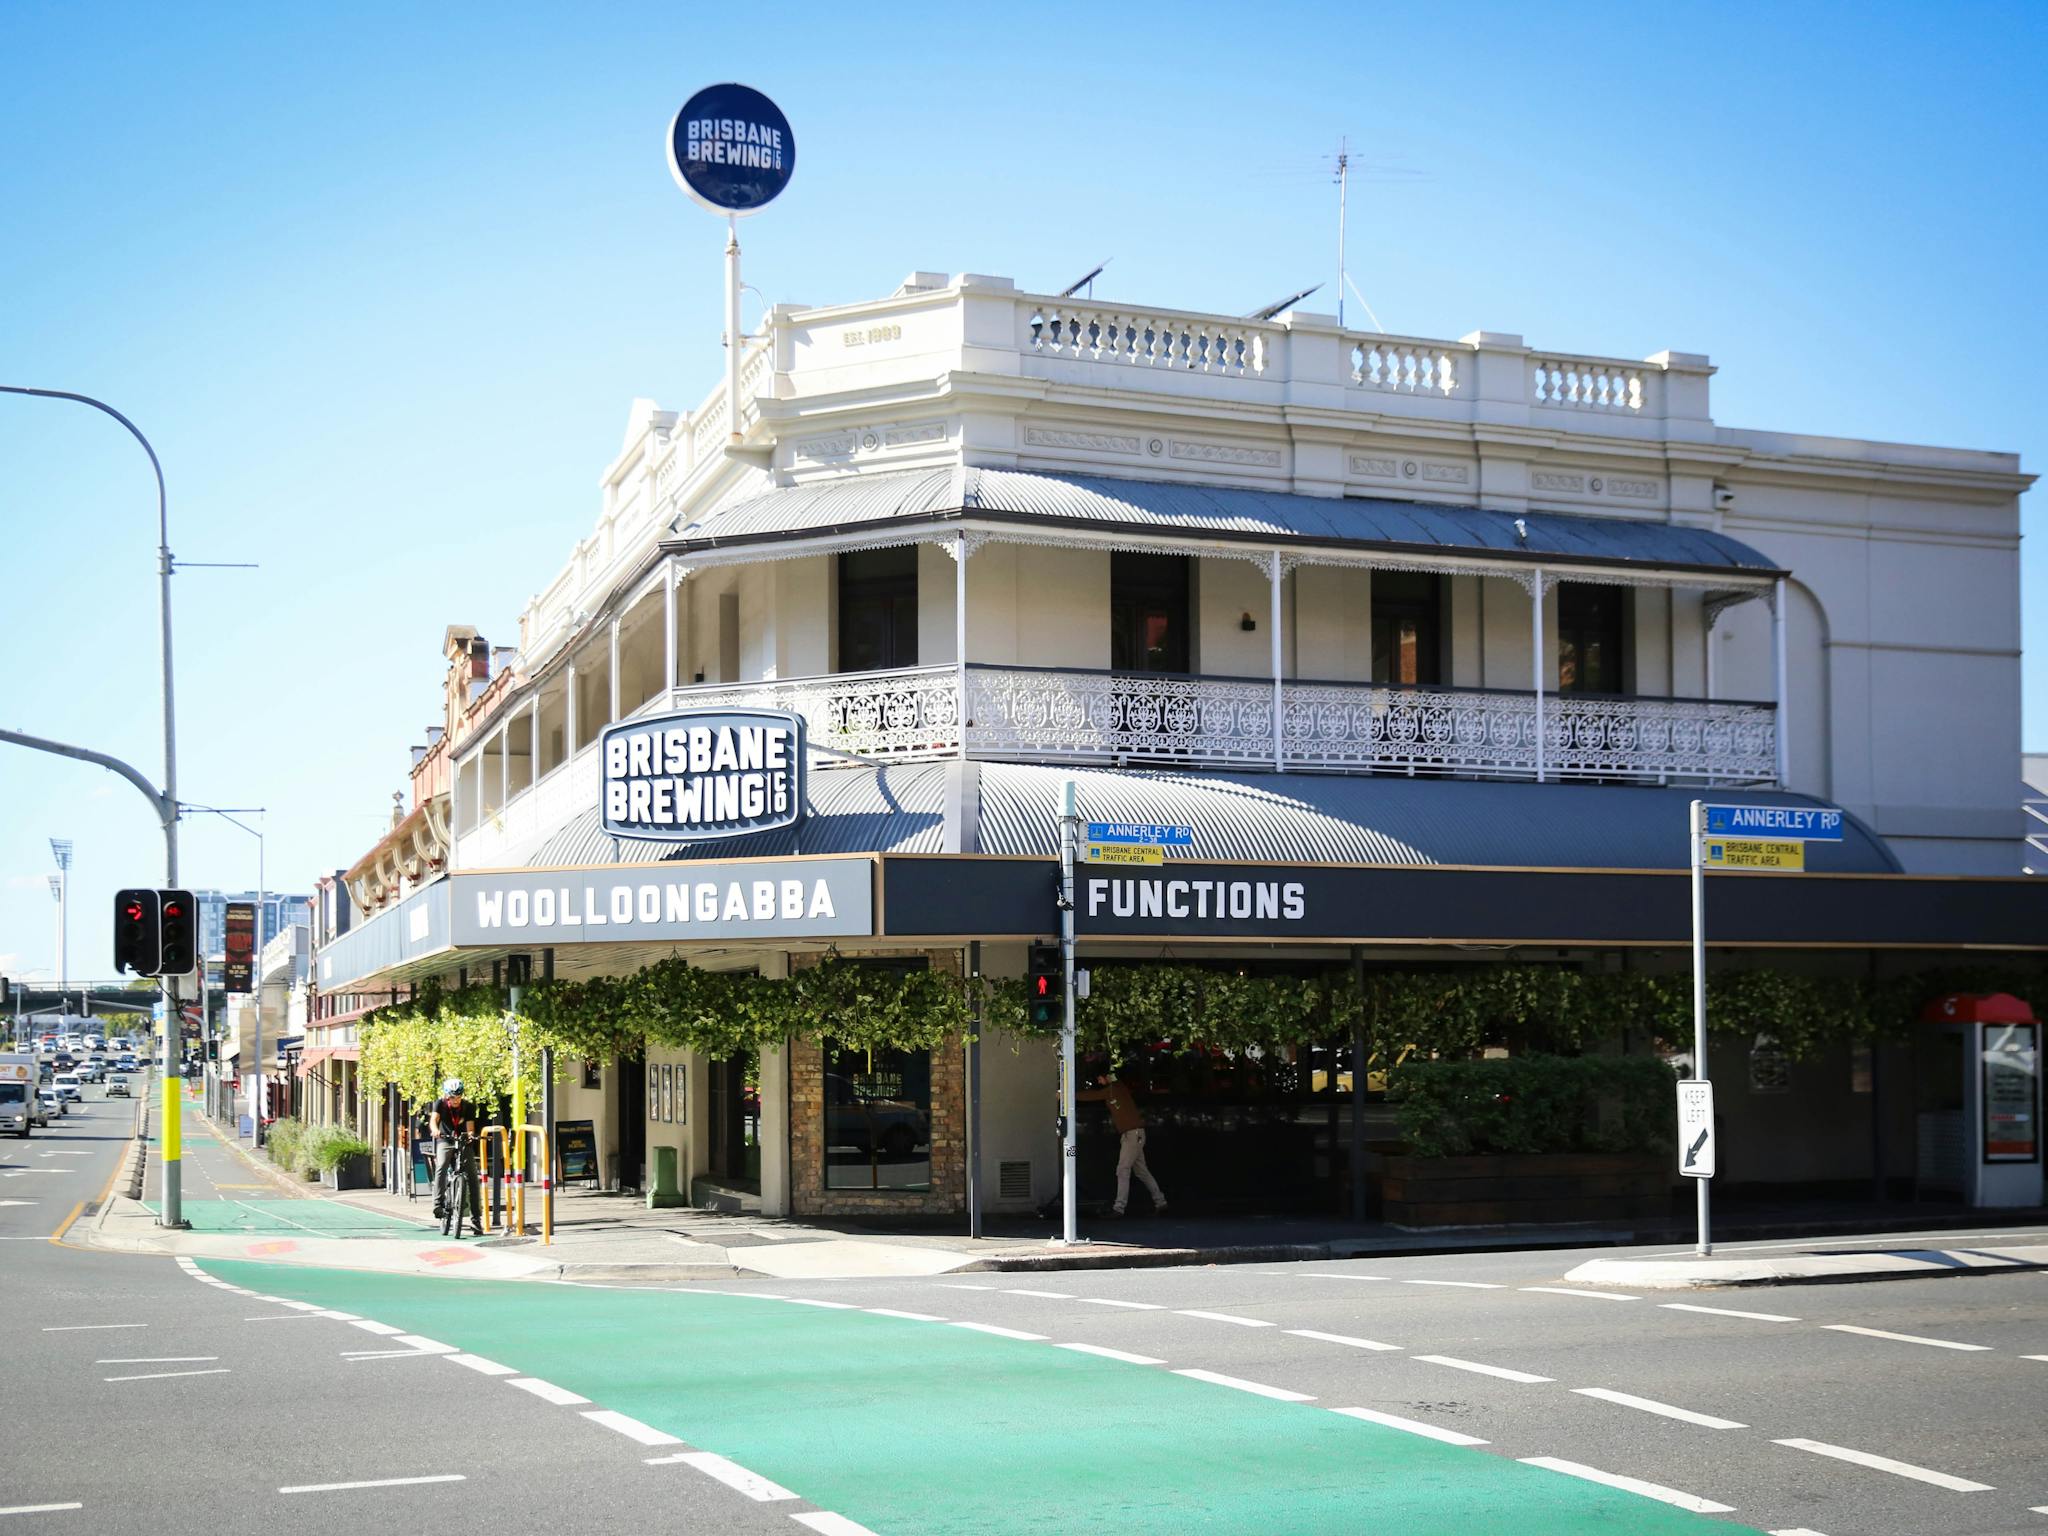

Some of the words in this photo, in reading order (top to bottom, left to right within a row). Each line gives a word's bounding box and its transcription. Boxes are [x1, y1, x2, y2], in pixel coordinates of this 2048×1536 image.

[688, 119, 781, 149] BRISBANE
[688, 140, 772, 169] BREWING
[606, 726, 787, 778] BRISBANE
[606, 773, 764, 823] BREWING
[1107, 824, 1170, 838] ANNERLEY
[1732, 809, 1815, 829] ANNERLEY
[1102, 846, 1131, 855] BRISBANE
[1133, 847, 1159, 856] CENTRAL
[1102, 854, 1127, 862] TRAFFIC
[1129, 855, 1145, 863] AREA
[1726, 841, 1763, 854] BRISBANE
[1766, 844, 1799, 855] CENTRAL
[1726, 854, 1757, 865] TRAFFIC
[1761, 855, 1781, 866] AREA
[477, 879, 837, 928] WOOLLOONGABBA
[1088, 879, 1305, 919] FUNCTIONS
